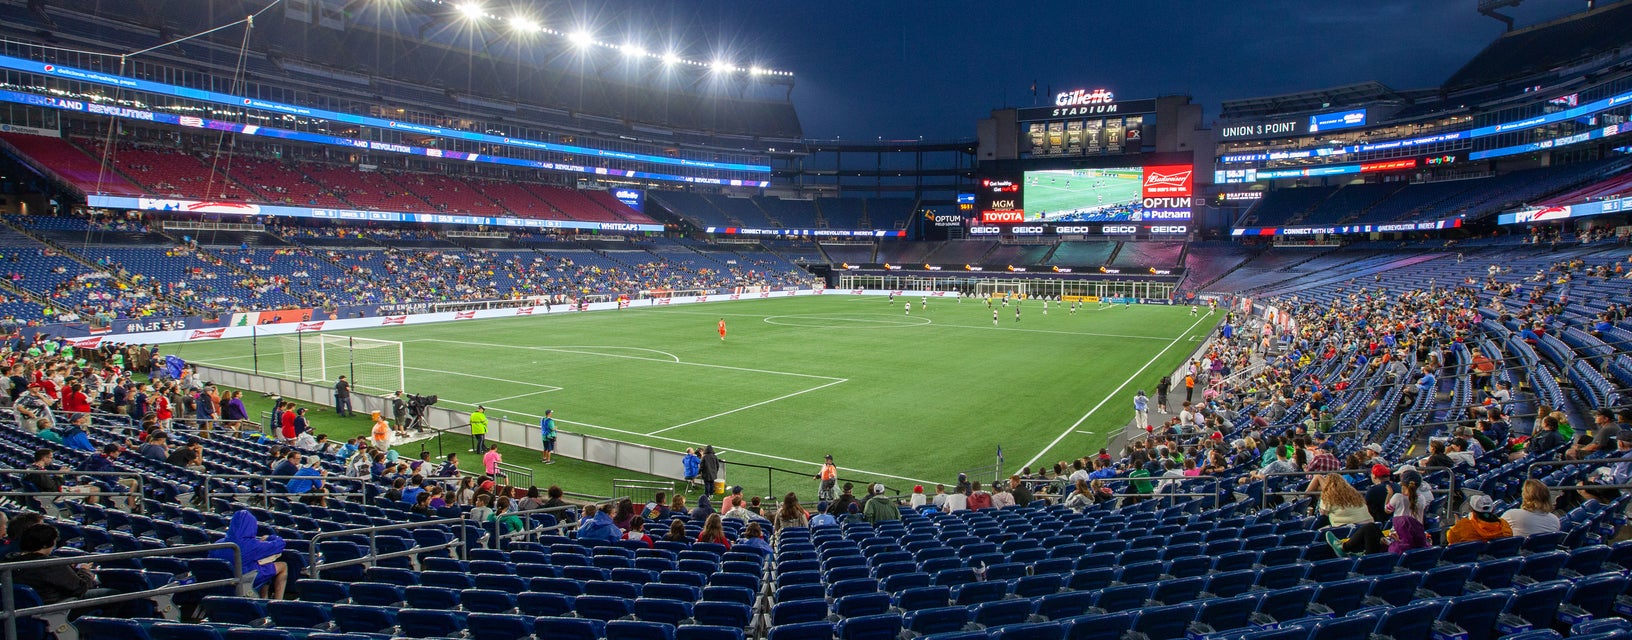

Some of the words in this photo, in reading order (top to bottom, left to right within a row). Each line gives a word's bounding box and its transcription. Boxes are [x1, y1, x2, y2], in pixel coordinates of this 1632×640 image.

[1056, 89, 1114, 106] Gillette
[88, 103, 154, 120] REVOLUTION
[1052, 105, 1118, 118] STADIUM
[1222, 125, 1254, 138] UNION
[1265, 121, 1297, 135] POINT
[1425, 156, 1442, 166] Party
[1442, 155, 1456, 164] City
[1148, 175, 1187, 183] Budweiser
[992, 200, 1015, 208] MGM
[1143, 197, 1192, 208] OPTUM
[984, 212, 1024, 221] TOYOTA
[1151, 210, 1192, 219] Putnam
[602, 223, 638, 231] WHITECAPS
[970, 226, 1000, 234] GEICO
[1012, 226, 1043, 234] GEICO
[1056, 226, 1089, 234] GEICO
[1150, 225, 1187, 233] GEICO
[1283, 227, 1311, 235] CONNECT
[1312, 227, 1326, 235] WITH
[1327, 226, 1335, 234] US
